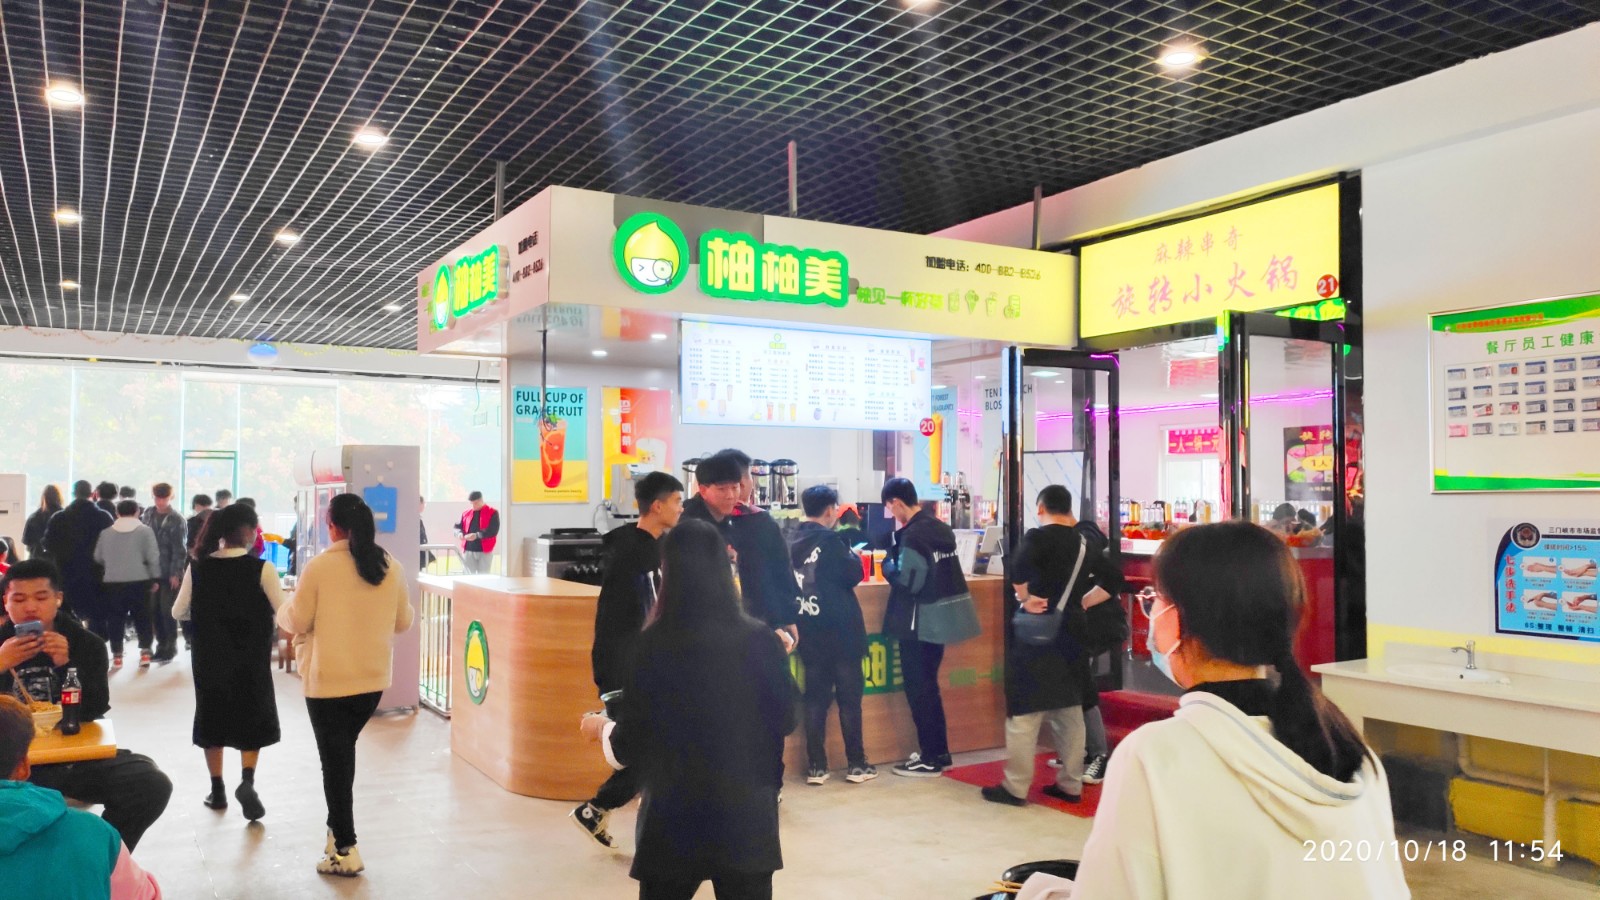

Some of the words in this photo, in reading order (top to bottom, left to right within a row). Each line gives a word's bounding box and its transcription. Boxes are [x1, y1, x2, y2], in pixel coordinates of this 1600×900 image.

[707, 237, 843, 299] 柚柚美
[1111, 255, 1298, 319] 旋转小火锅
[1318, 277, 1337, 295] 21
[1486, 330, 1595, 355] 餐厅员工健康
[545, 391, 567, 403] CUP
[570, 392, 583, 404] OF
[516, 405, 583, 417] GRAEFRUIT
[920, 422, 935, 433] 20
[1548, 526, 1600, 535] 三门峡市市场监
